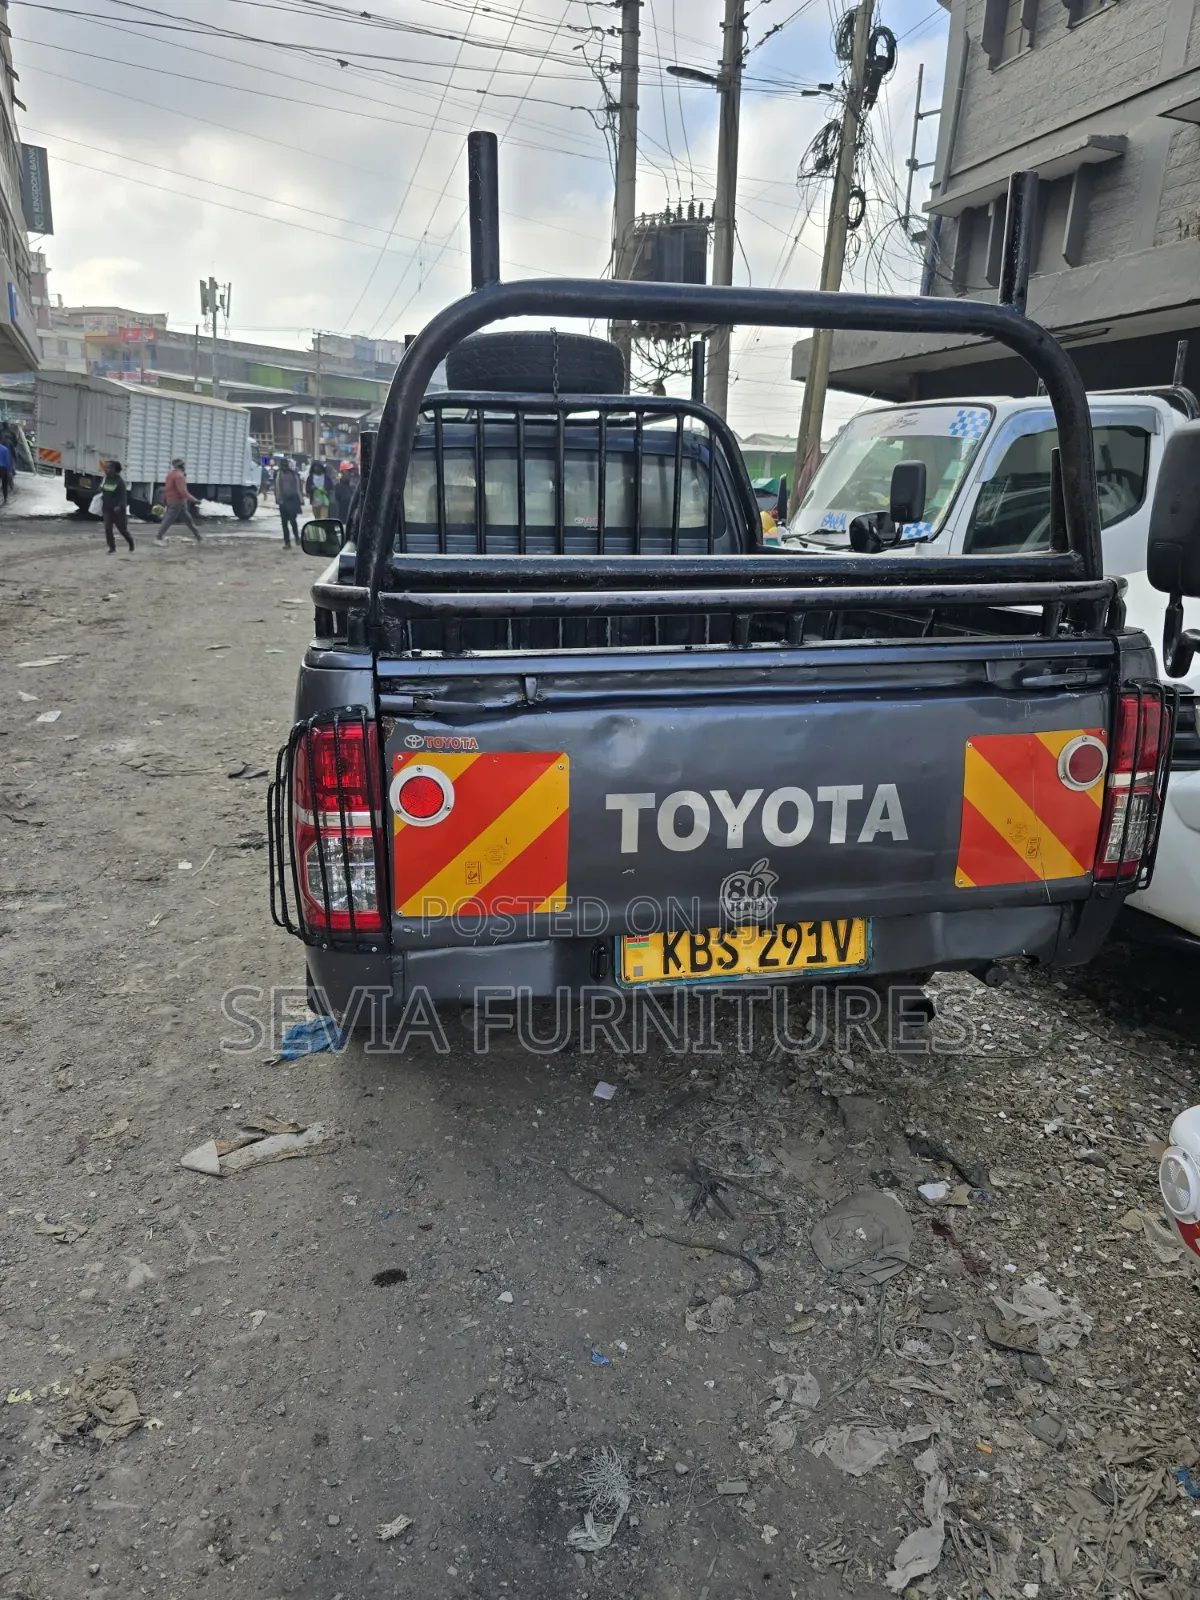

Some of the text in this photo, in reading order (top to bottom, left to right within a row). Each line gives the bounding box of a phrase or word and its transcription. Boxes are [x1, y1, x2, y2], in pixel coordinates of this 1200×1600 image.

[28, 146, 37, 170] BANK
[31, 172, 41, 212] KINGDOM
[424, 736, 479, 749] TOYOTA
[605, 784, 909, 854] TOYOTA
[727, 877, 766, 901] 80
[662, 925, 739, 976] KBS
[757, 918, 854, 967] 291V
